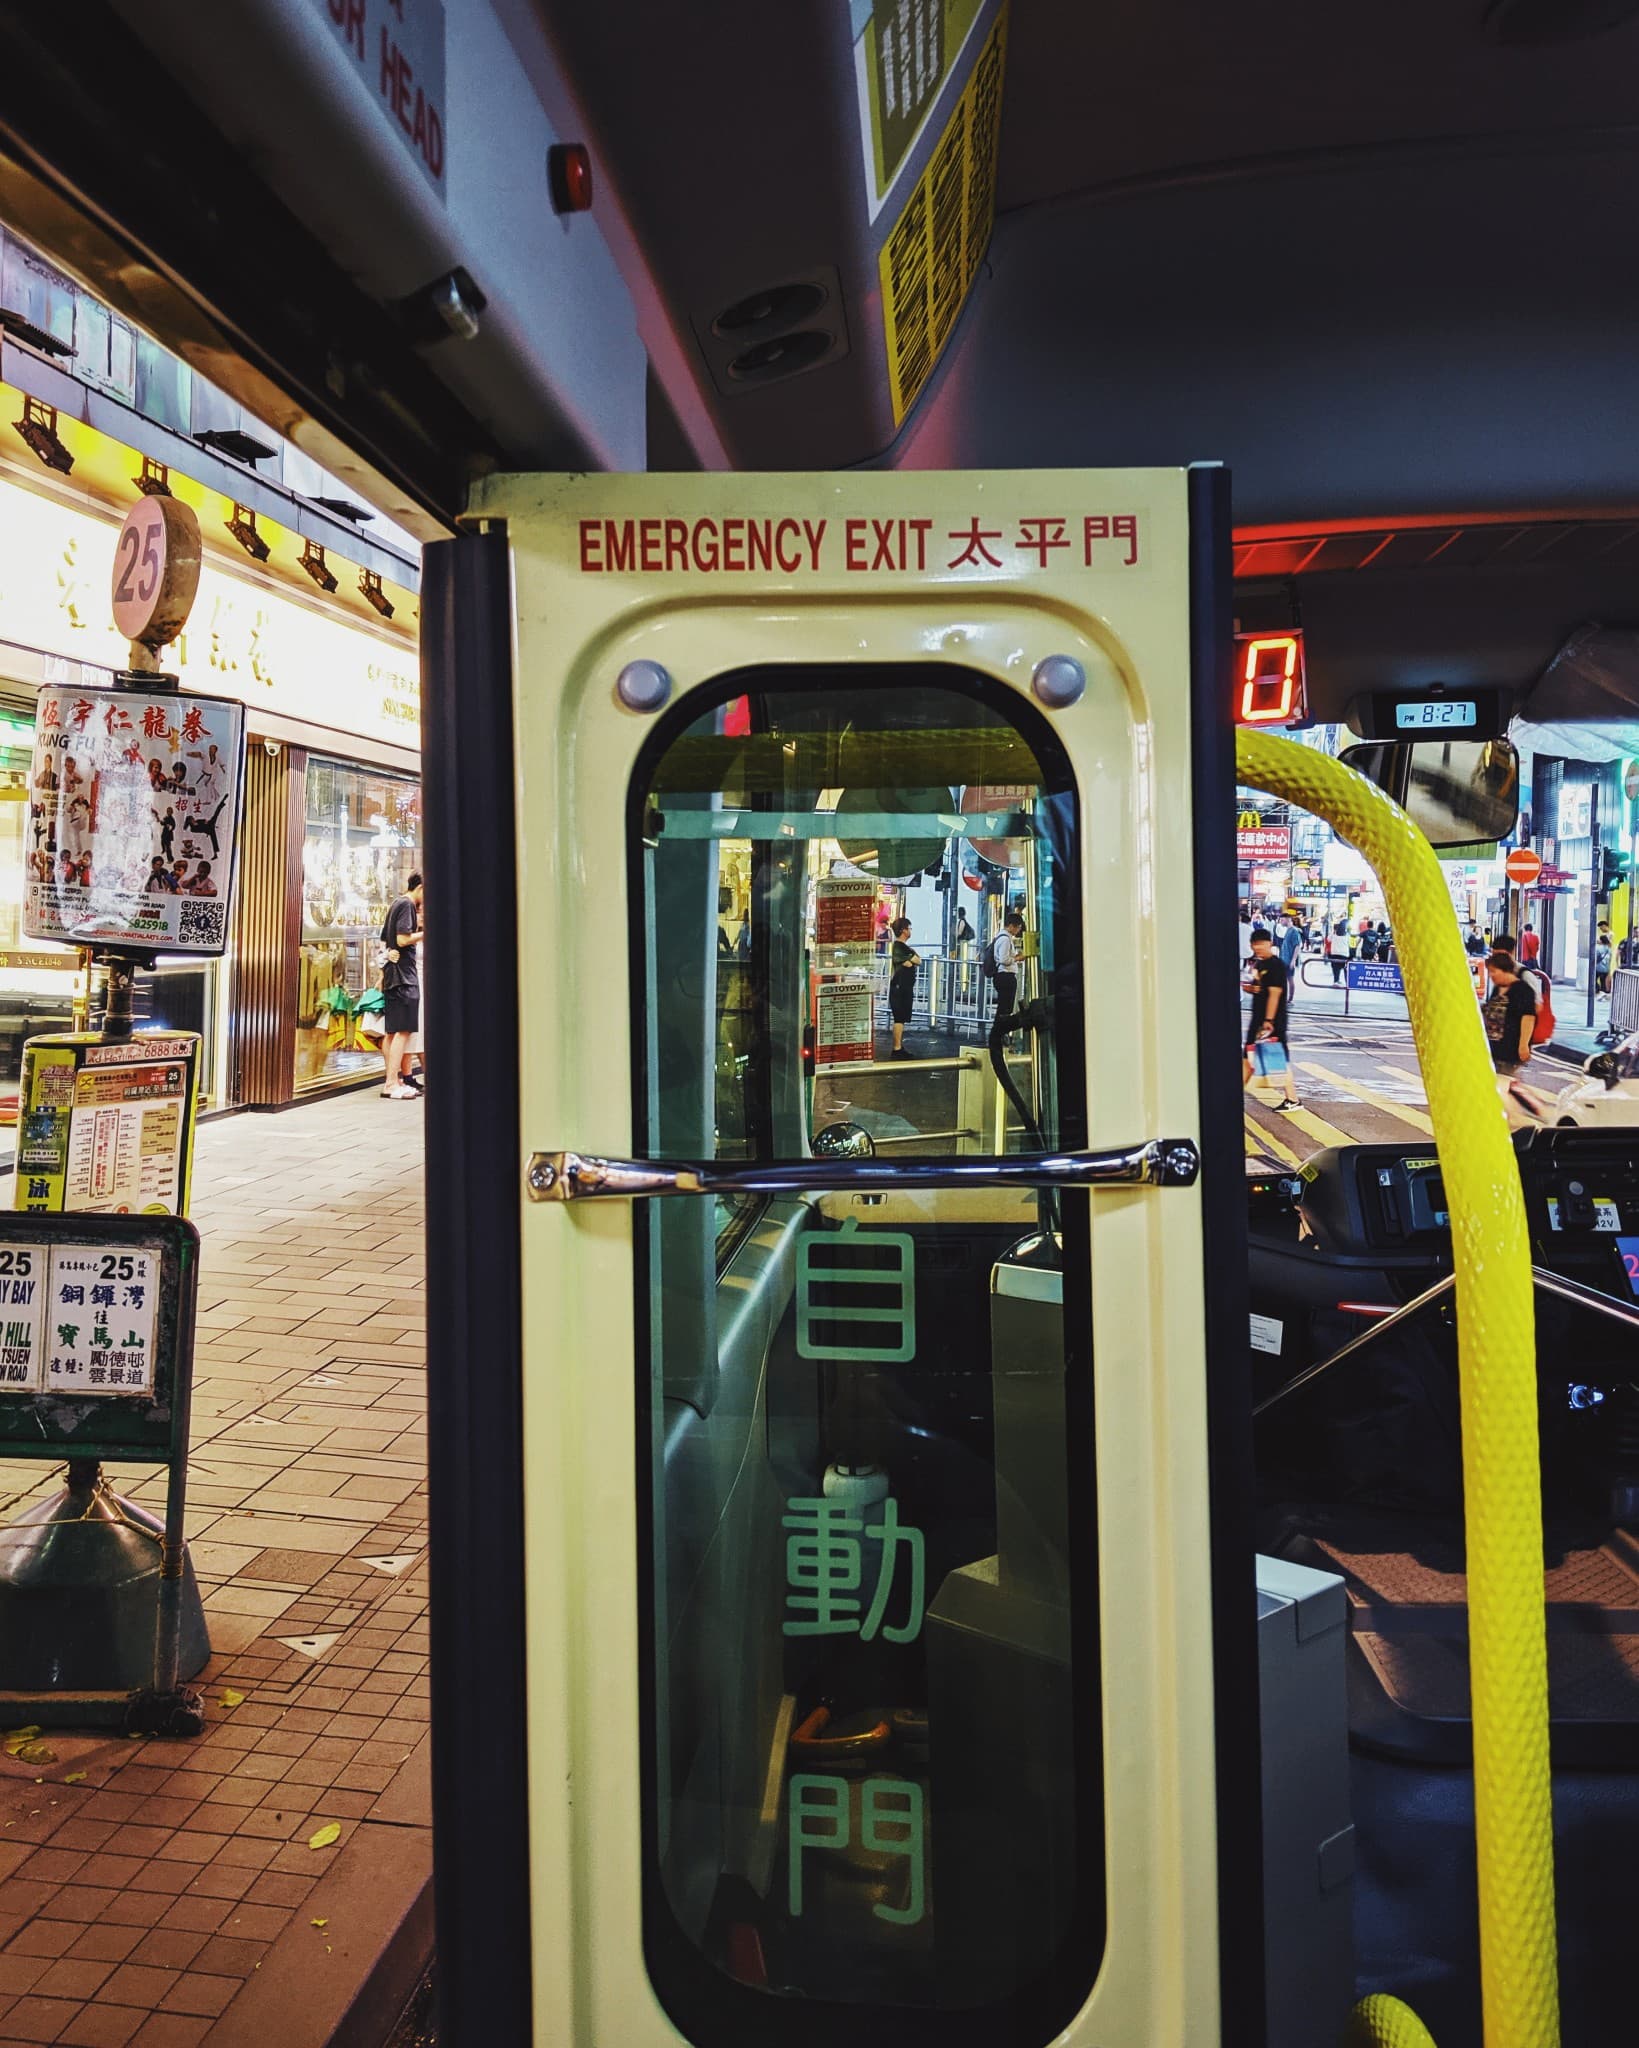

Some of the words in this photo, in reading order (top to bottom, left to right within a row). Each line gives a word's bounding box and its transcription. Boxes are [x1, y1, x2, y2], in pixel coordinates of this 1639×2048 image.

[379, 24, 443, 179] HEAD
[579, 518, 827, 573] EMERGENCY
[845, 518, 932, 572] EXIT
[947, 515, 1138, 569] 太平門
[114, 523, 162, 602] 25
[1242, 637, 1297, 721] 0
[1404, 714, 1415, 722] PM
[1422, 704, 1467, 723] 8:27
[37, 733, 70, 750] KUNG
[834, 883, 872, 892] TOYOTA
[834, 984, 867, 993] TOYOTA
[168, 1072, 178, 1081] 25
[0, 1251, 32, 1277] 25
[100, 1255, 134, 1281] 25
[11, 1280, 36, 1305] BAY
[59, 1284, 145, 1310] 銅鑼灣
[94, 1310, 109, 1325] 往
[5, 1321, 32, 1348] HILL
[57, 1323, 145, 1349] 寶馬山
[1, 1349, 31, 1365] TSUEN
[90, 1350, 145, 1369] 勵德邨
[7, 1365, 28, 1382] ROAD
[89, 1368, 144, 1385] 雲景道
[782, 1215, 926, 1927] 自動門
